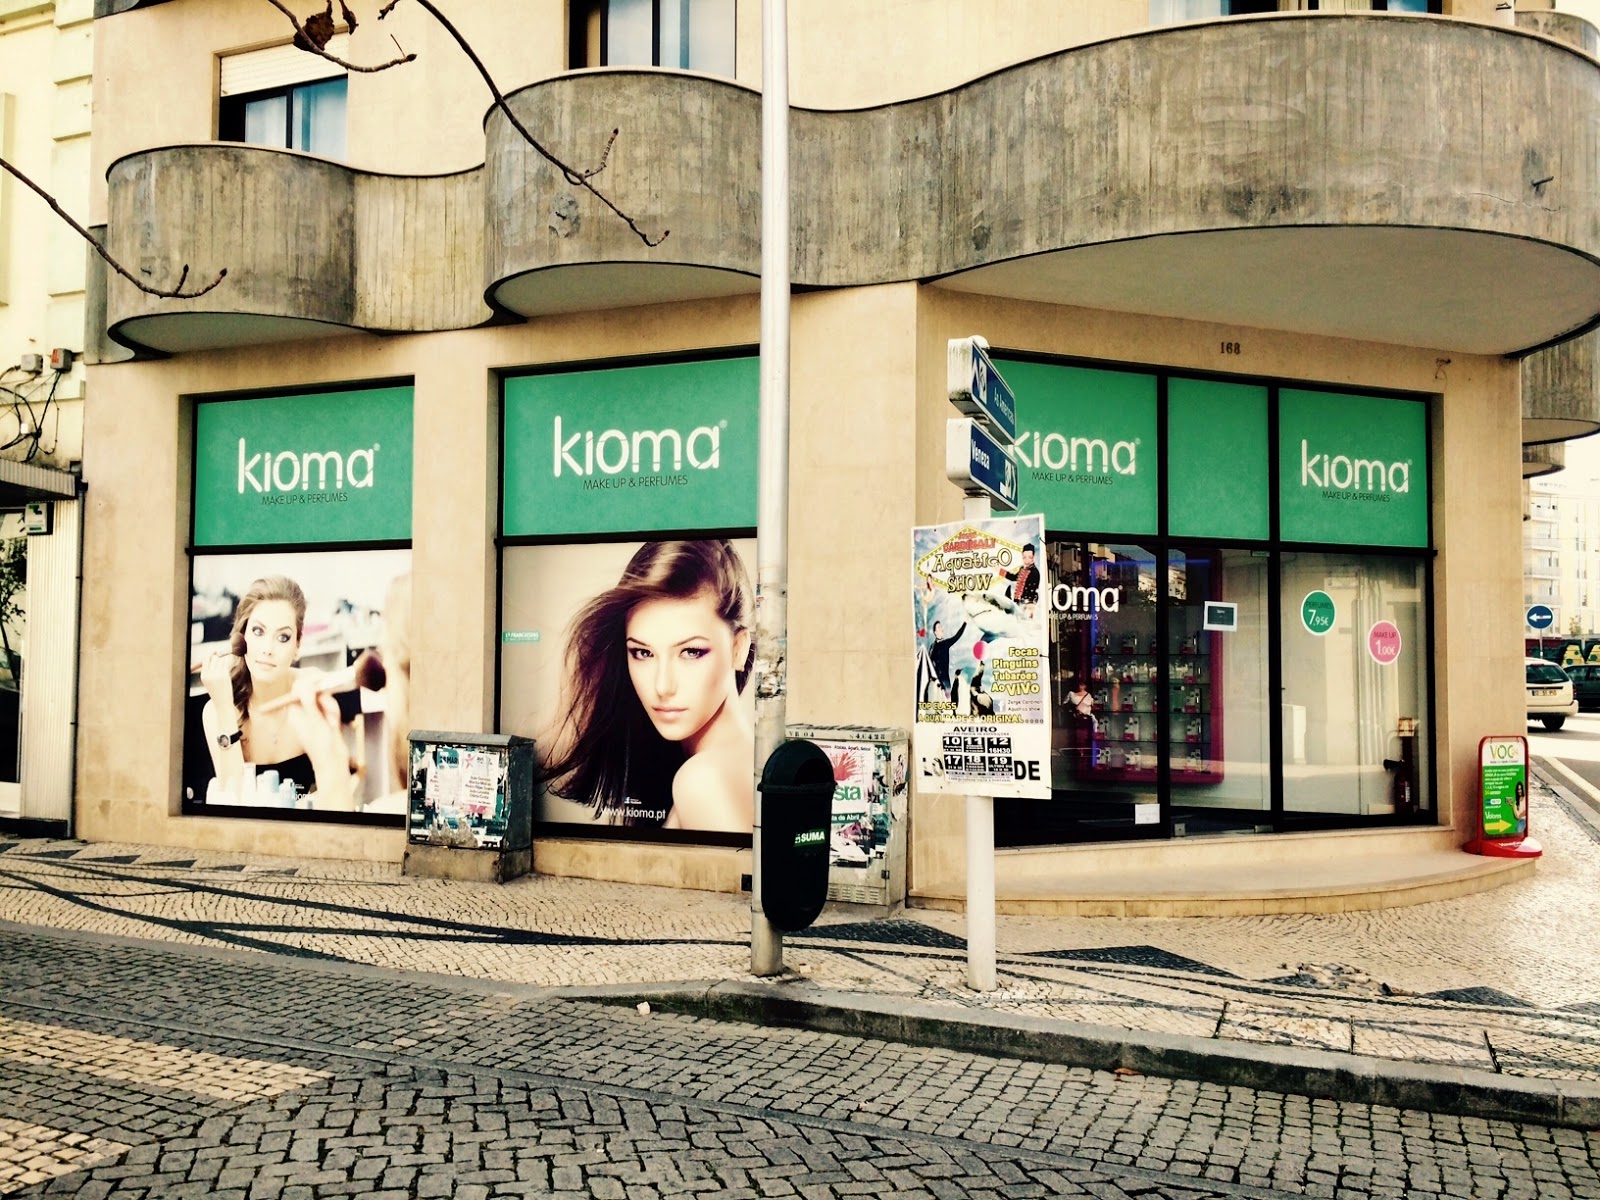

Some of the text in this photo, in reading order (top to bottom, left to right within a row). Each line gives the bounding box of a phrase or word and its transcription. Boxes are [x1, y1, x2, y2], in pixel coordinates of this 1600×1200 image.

[1221, 342, 1241, 355] 168
[553, 415, 720, 478] kioma
[971, 440, 990, 470] Veneza
[238, 437, 375, 494] kioma
[1301, 439, 1409, 493] kioma
[583, 475, 688, 490] MAKE UP & PERFUMES
[1031, 472, 1114, 485] MAKE UP & PERFUMES
[261, 492, 348, 506] MAKE UP & PERFUMES
[1322, 491, 1341, 500] MAKE
[1342, 492, 1350, 500] UP
[1359, 493, 1391, 503] PERFUMES
[947, 573, 993, 593] SHOW
[1048, 583, 1119, 612] ioma
[1009, 647, 1038, 657] Focas
[992, 658, 1039, 671] Pinguins
[992, 670, 1038, 681] Tubarões
[991, 682, 1005, 692] Ao
[918, 702, 957, 710] TOP CLASS
[943, 737, 1009, 745] 10 11 12
[945, 755, 961, 765] 17
[991, 757, 1008, 765] 19
[600, 806, 666, 821] www.kioma.pt
[847, 813, 860, 821] Abril
[800, 831, 825, 842] SUMA
